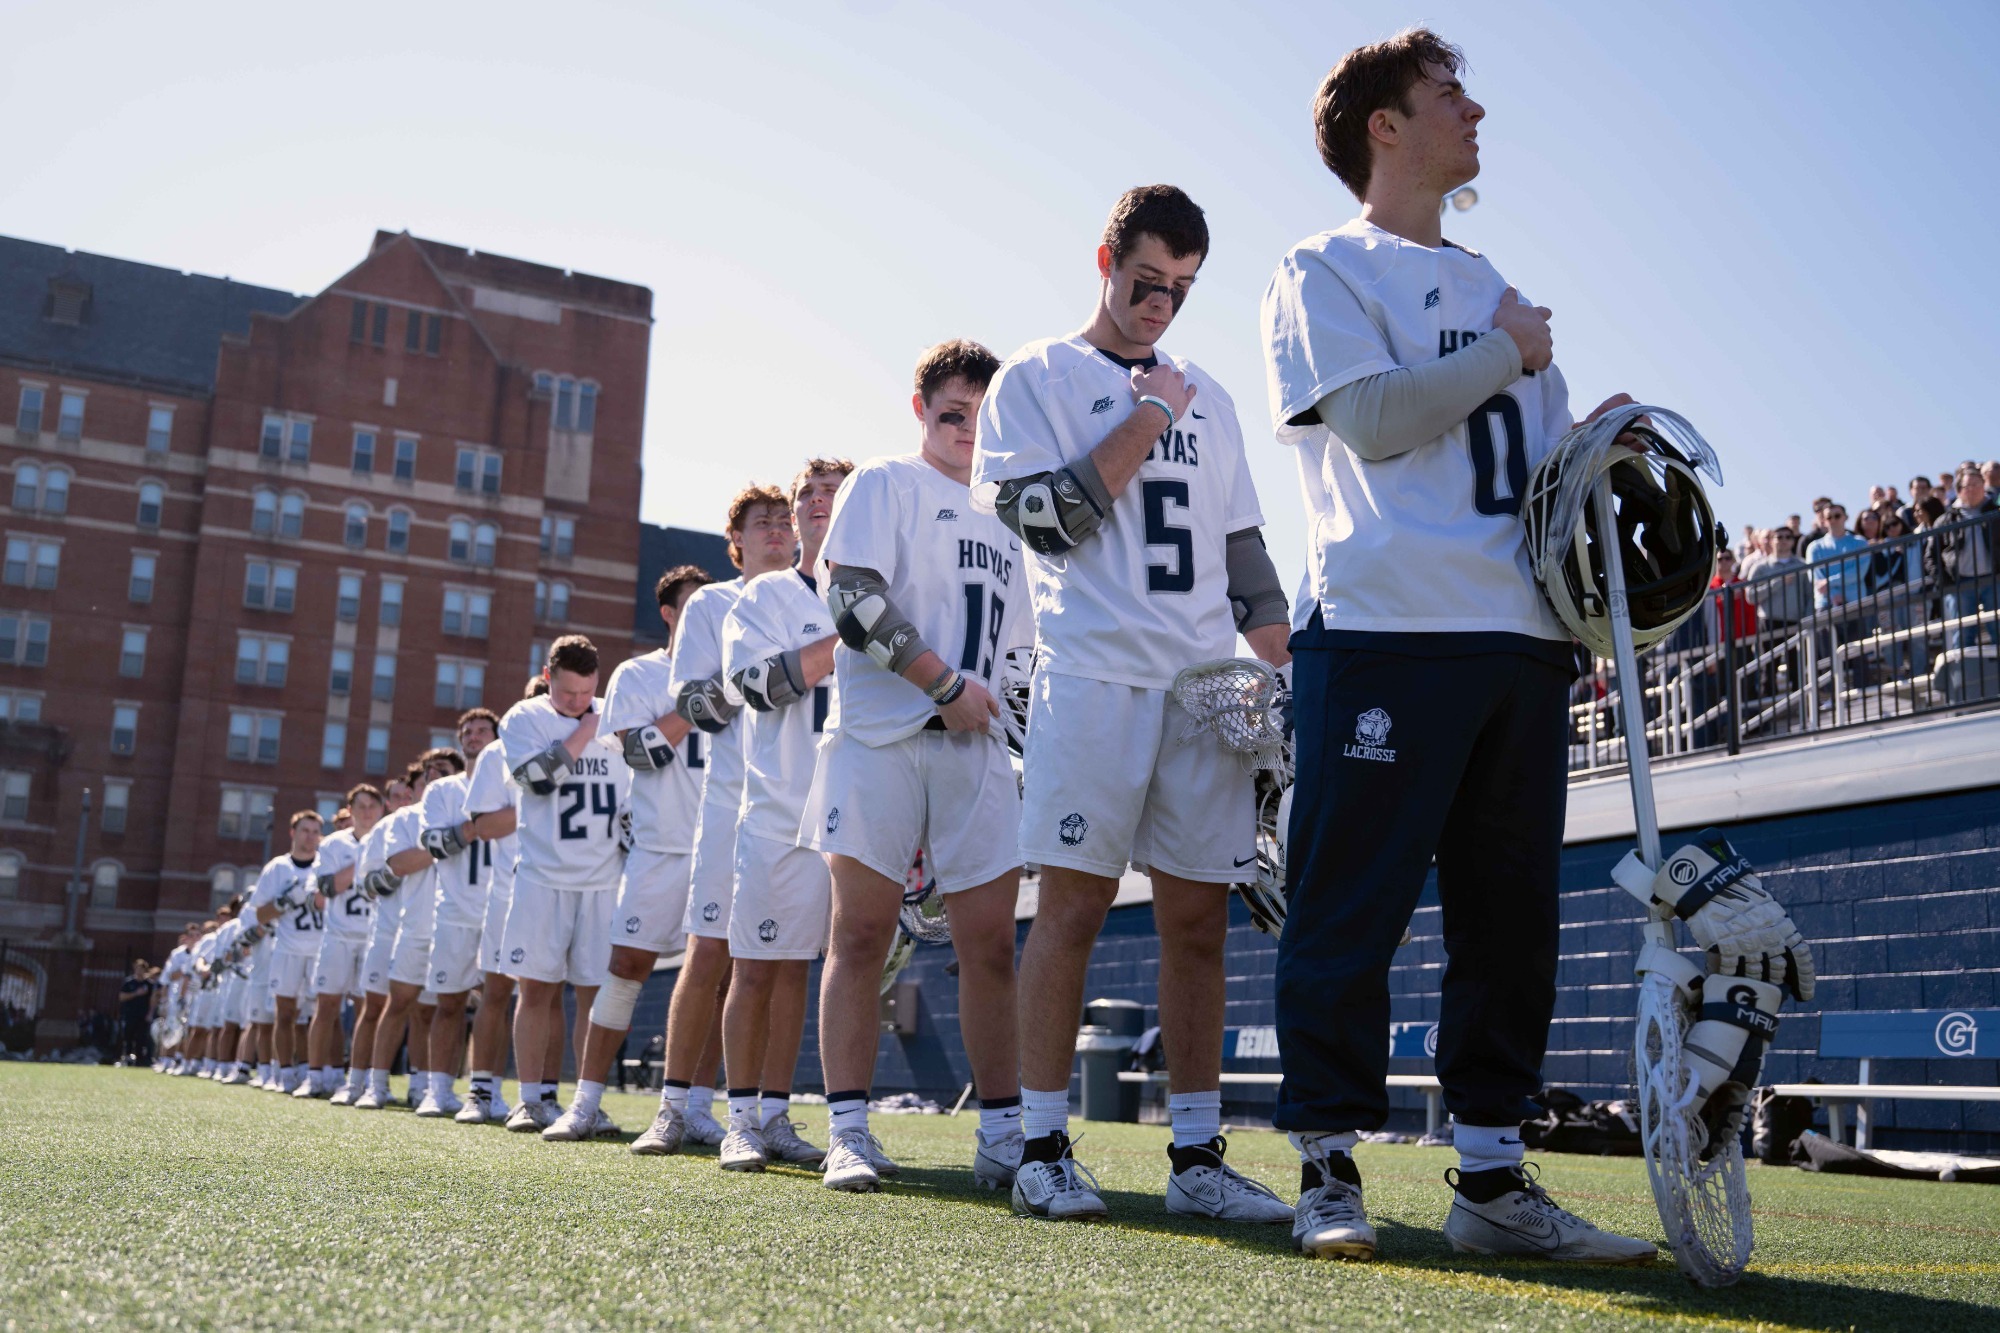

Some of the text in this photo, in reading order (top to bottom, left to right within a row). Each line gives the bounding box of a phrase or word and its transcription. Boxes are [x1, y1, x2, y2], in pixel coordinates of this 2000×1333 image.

[1145, 429, 1199, 467] YAS
[1464, 389, 1529, 519] 0
[958, 538, 1012, 588] HOYAS
[1139, 477, 1195, 595] 5
[959, 581, 1005, 682] 19
[569, 757, 609, 776] OYAS
[1342, 743, 1397, 762] LACROSSE
[558, 782, 617, 841] 24
